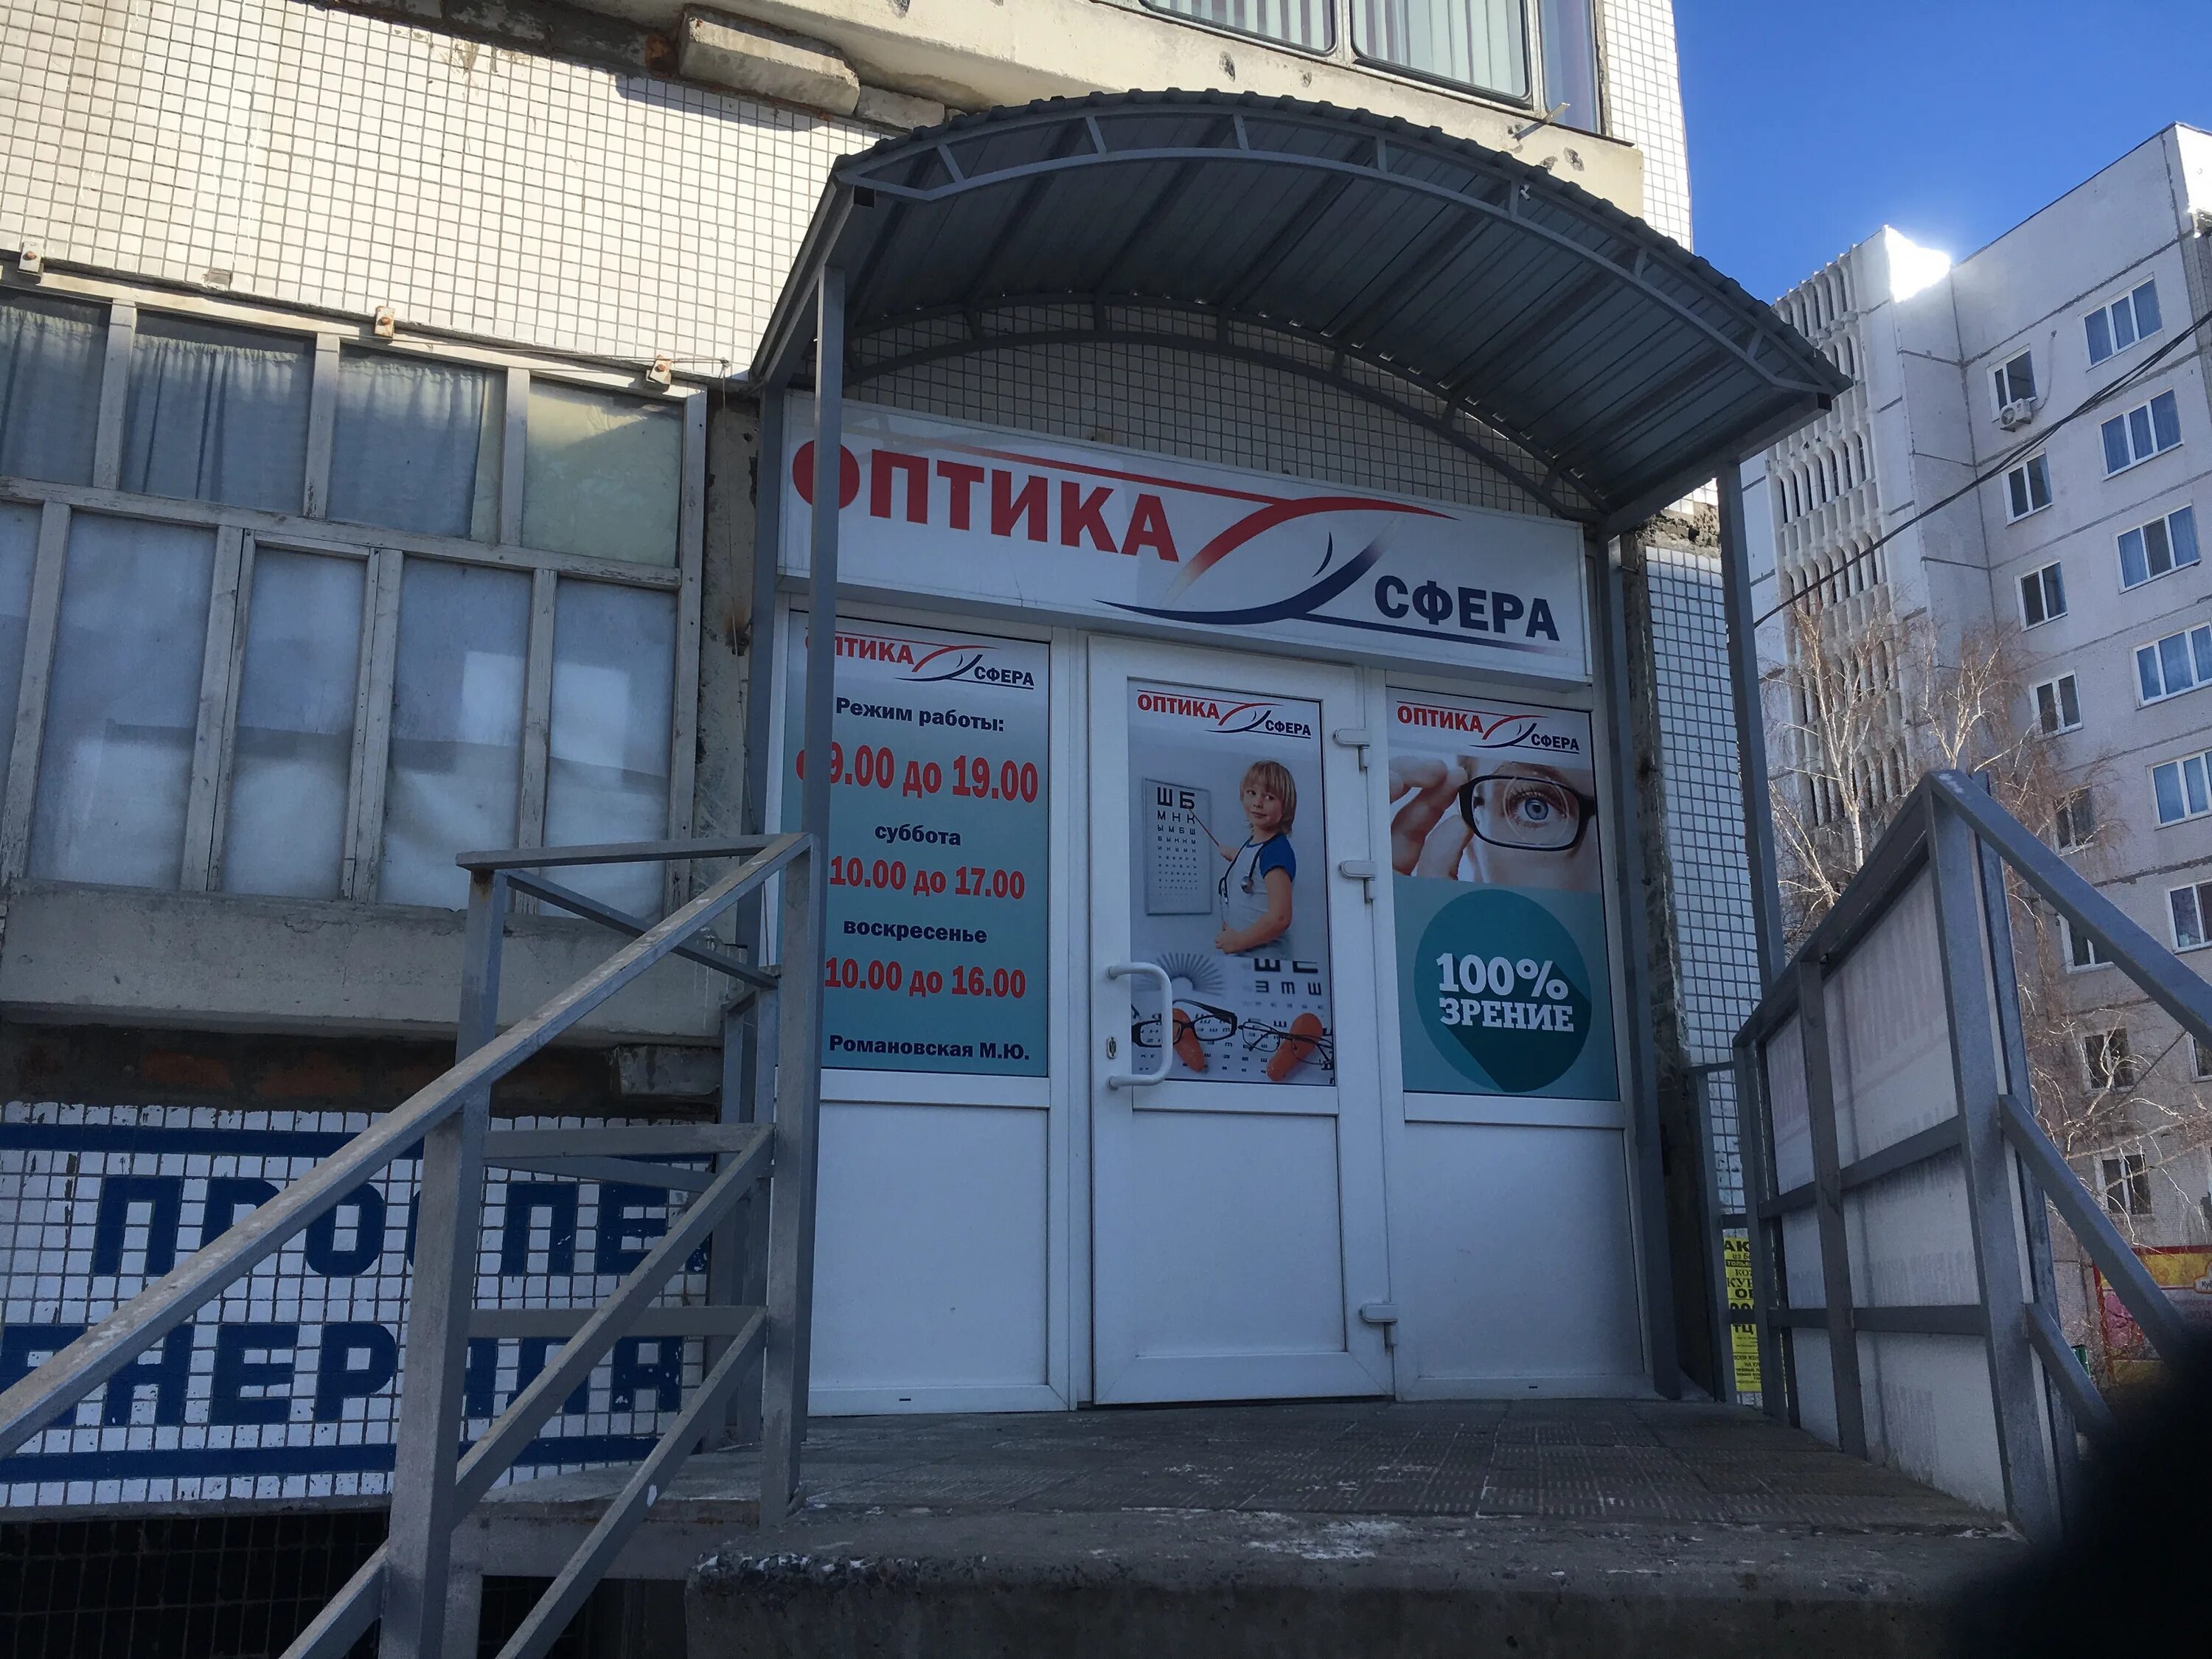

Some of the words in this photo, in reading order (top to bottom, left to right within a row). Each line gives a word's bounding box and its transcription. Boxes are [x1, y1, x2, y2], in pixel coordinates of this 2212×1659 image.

[793, 440, 1179, 562] ОПТИКА
[1374, 575, 1560, 641] СФЕРА
[805, 636, 914, 664] ТИКА
[974, 667, 1034, 686] СФЕРА
[836, 698, 912, 721] Режим
[919, 710, 1004, 732] работы:
[1138, 695, 1220, 720] ОПТИКА
[1397, 706, 1484, 733] ОПТИКА
[1265, 720, 1311, 736] СФЕРА
[1531, 733, 1579, 751] СФЕРА
[902, 761, 942, 799] до
[952, 755, 1038, 803] 19.00
[875, 824, 961, 846] суббота
[830, 855, 906, 890] 10.00
[914, 870, 946, 897] до
[955, 866, 1025, 900] 17.00
[844, 920, 987, 943] воскресенье
[824, 957, 902, 991] 10.00
[909, 970, 942, 997] до
[952, 965, 1026, 998] 16.00
[1436, 953, 1568, 1000] 100%
[1439, 997, 1574, 1032] ЗРЕНИЕ
[830, 1034, 973, 1057] Романовская
[979, 1042, 1030, 1060] М.Ю.
